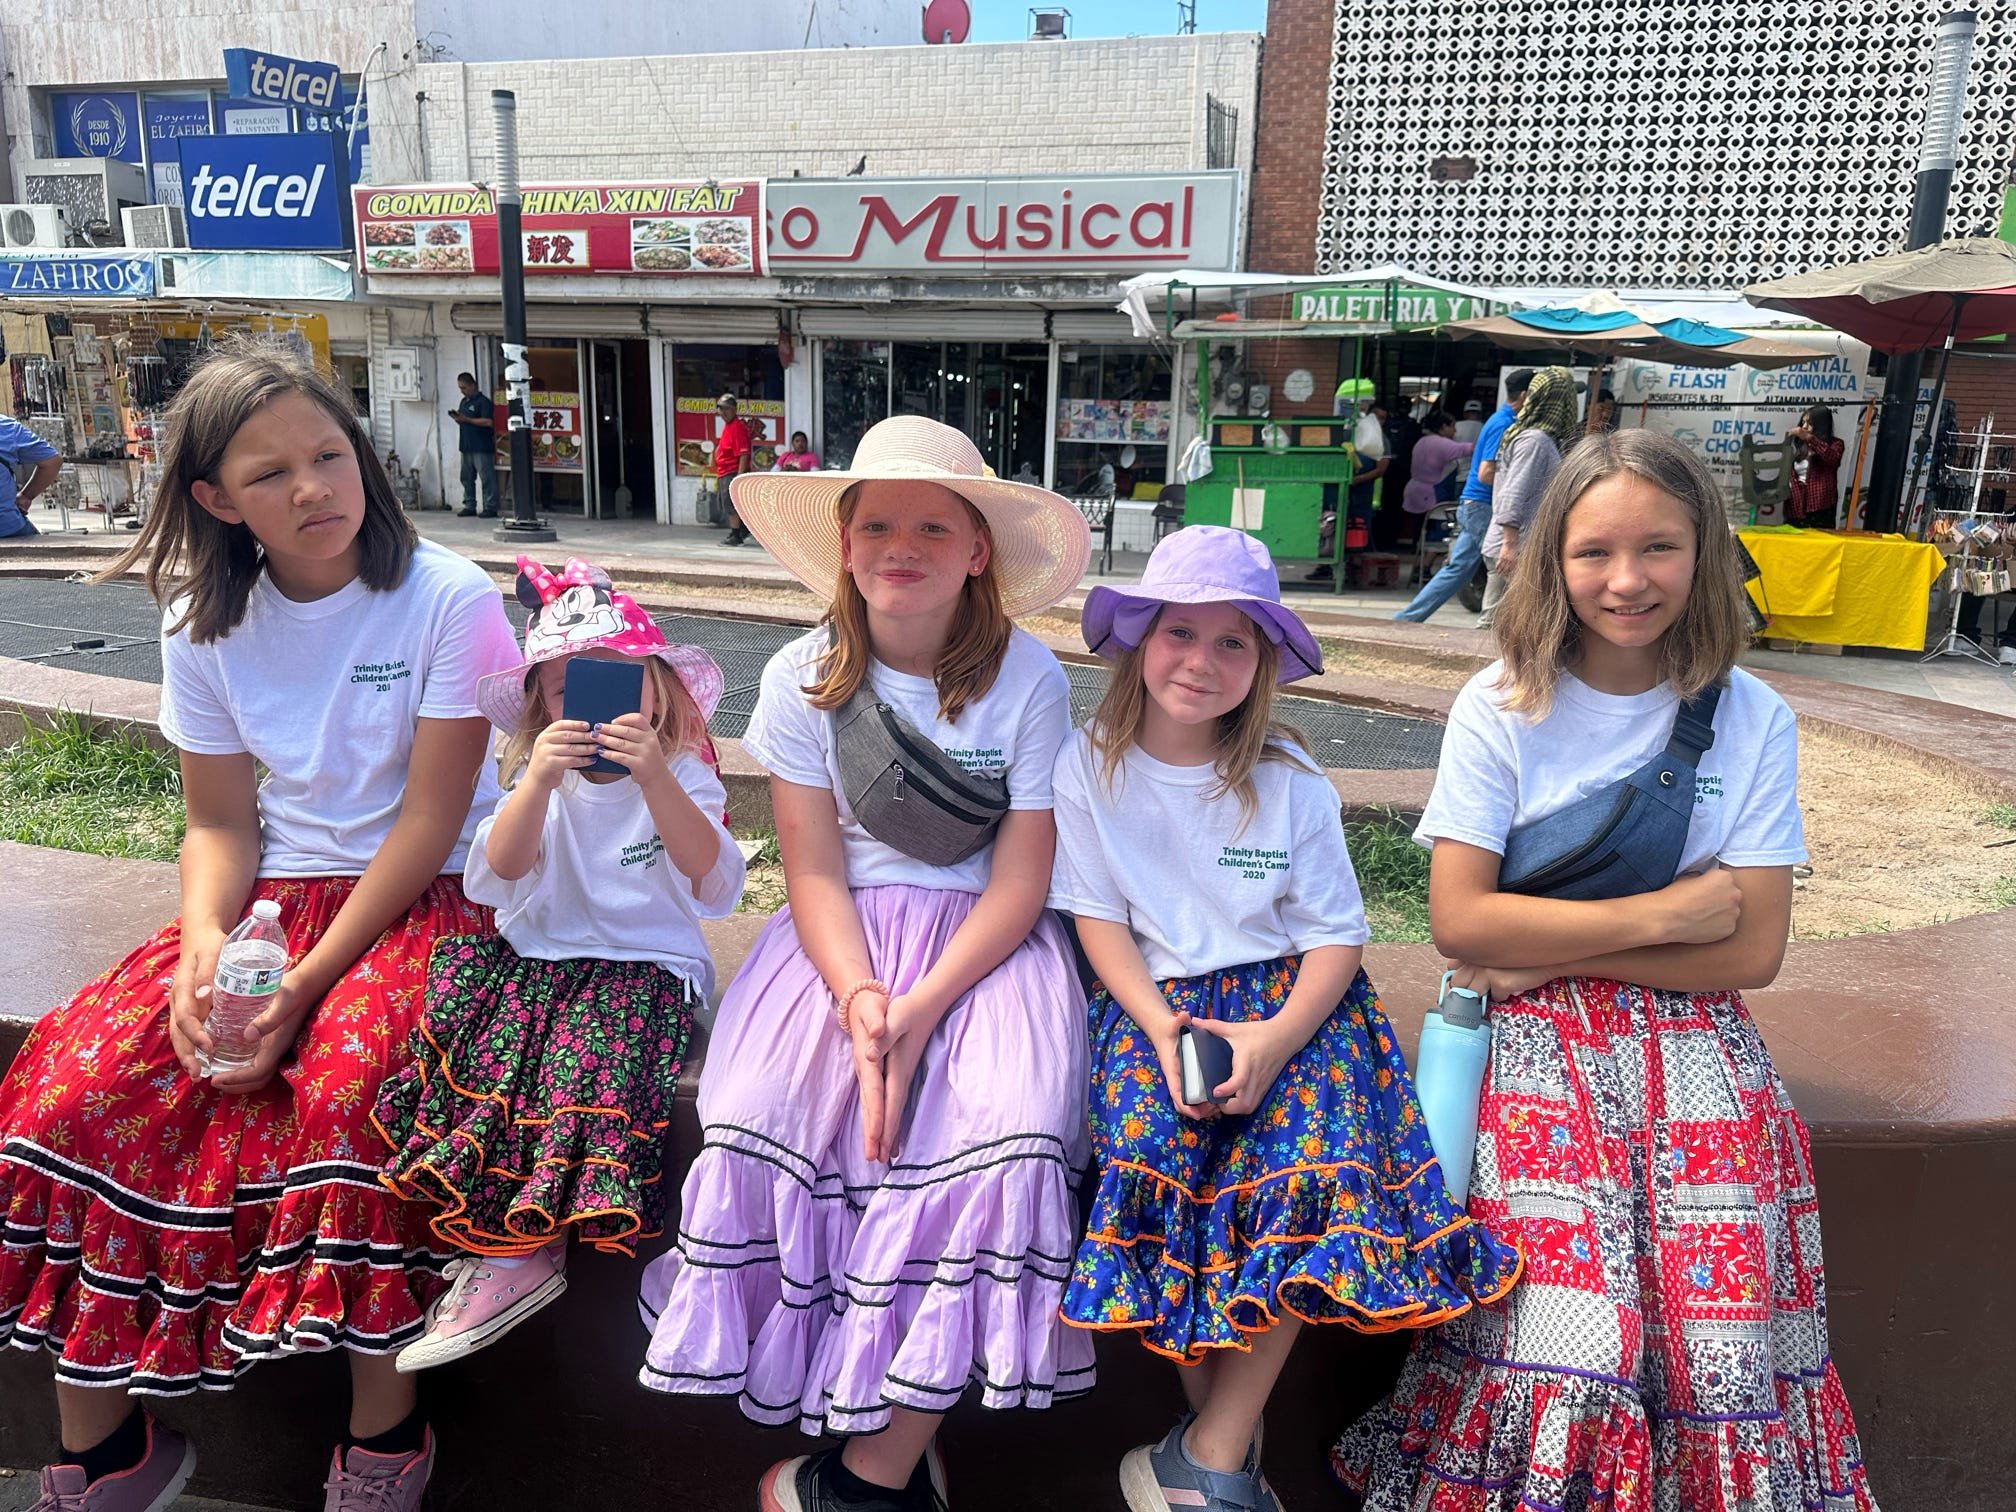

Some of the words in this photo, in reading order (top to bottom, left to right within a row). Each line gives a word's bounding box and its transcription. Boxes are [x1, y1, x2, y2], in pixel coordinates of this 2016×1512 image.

[251, 56, 340, 108] telcel
[87, 120, 110, 130] DESDE
[151, 125, 166, 139] EL
[246, 125, 280, 133] INSTANTE
[89, 132, 110, 146] 1910
[191, 164, 326, 218] telcel
[369, 191, 495, 216] COMIDA
[519, 189, 601, 214] HINA
[605, 188, 666, 213] XIN
[669, 187, 742, 212] FAT
[852, 186, 1194, 262] Musical
[527, 235, 575, 264] 新发
[1300, 295, 1439, 323] PALETERIA
[1445, 297, 1464, 322] Y
[1788, 358, 1852, 373] DENTAL
[1668, 373, 1727, 389] FLASH
[1778, 374, 1857, 391] ECONOMICA
[1712, 420, 1776, 436] DENTAL
[353, 664, 384, 673] Trinity
[944, 748, 974, 759] Trinity
[975, 748, 1002, 758] Baptist
[984, 758, 1006, 768] Camp
[621, 841, 650, 855] Trinity
[1222, 847, 1253, 859] Trinity
[1255, 849, 1288, 860] Baptist
[1218, 858, 1263, 869] Children's
[1264, 861, 1290, 871] Camp
[1242, 870, 1266, 880] 2020
